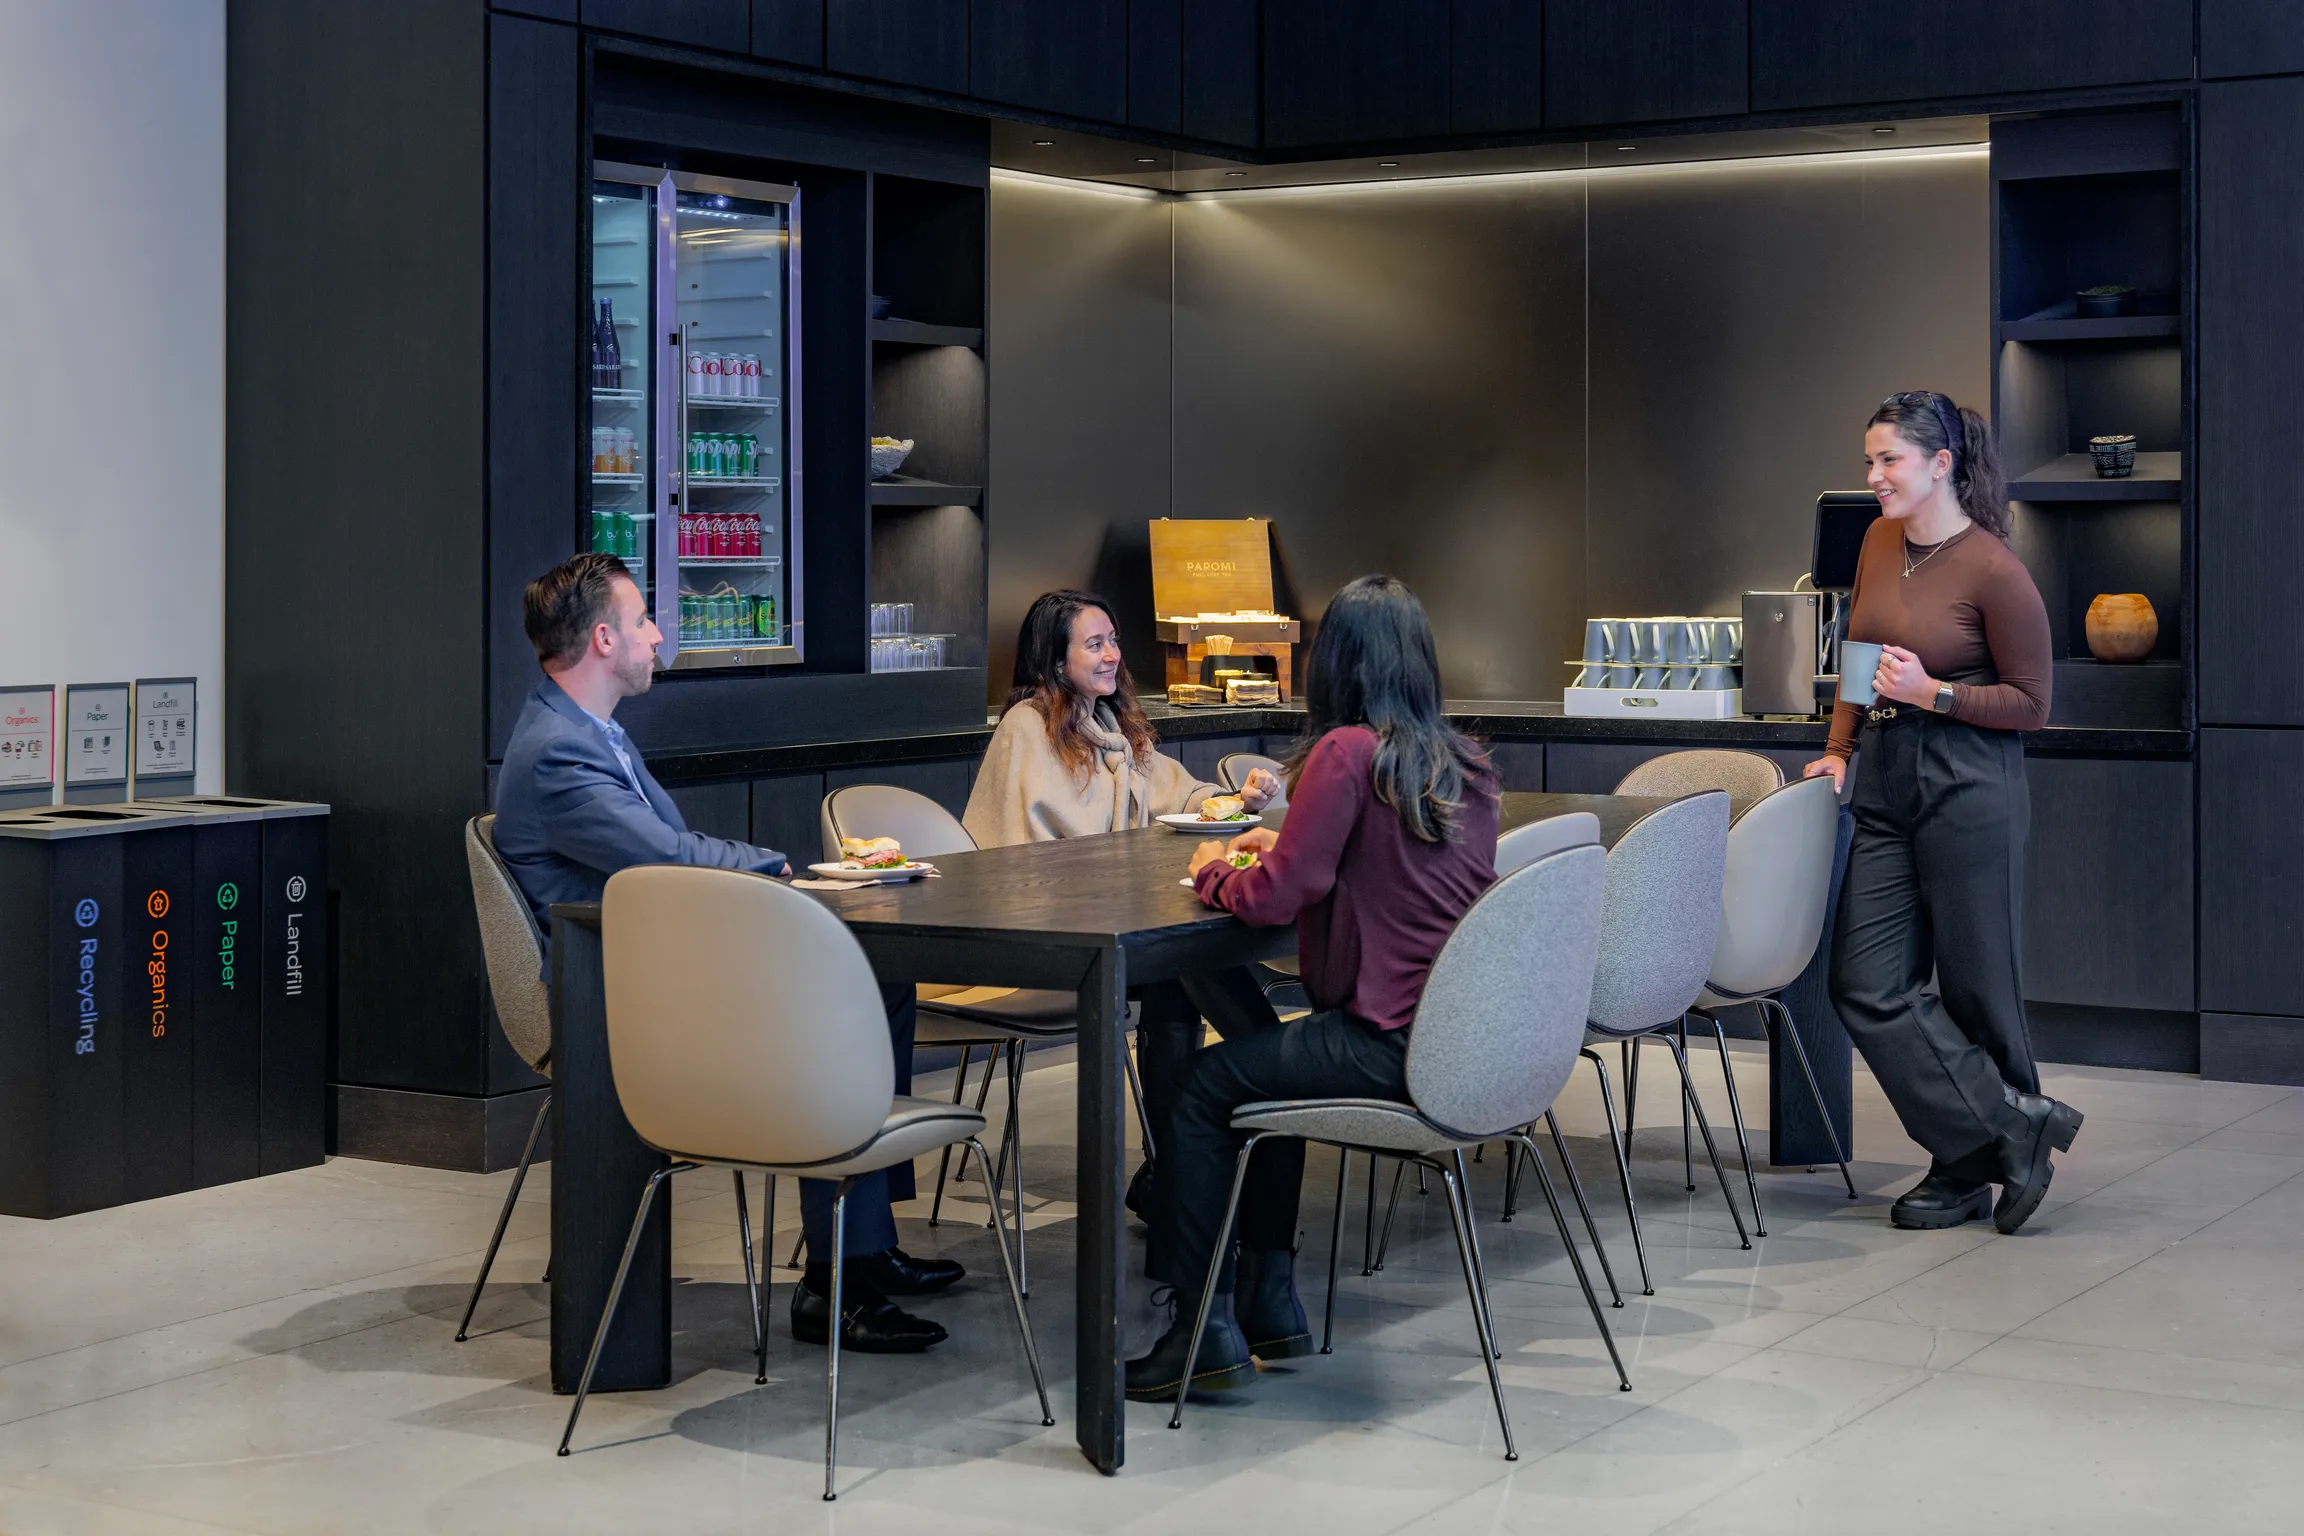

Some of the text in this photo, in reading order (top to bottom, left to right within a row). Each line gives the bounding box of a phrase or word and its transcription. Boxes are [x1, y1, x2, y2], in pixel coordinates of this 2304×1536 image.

[1187, 562, 1236, 571] PAROMI
[5, 716, 39, 727] Organics
[86, 712, 109, 722] Paper
[152, 700, 179, 709] Landfill
[217, 920, 238, 990] Paper
[285, 913, 303, 996] Landfill
[75, 938, 99, 1055] Recycling
[147, 930, 169, 1038] Organics
